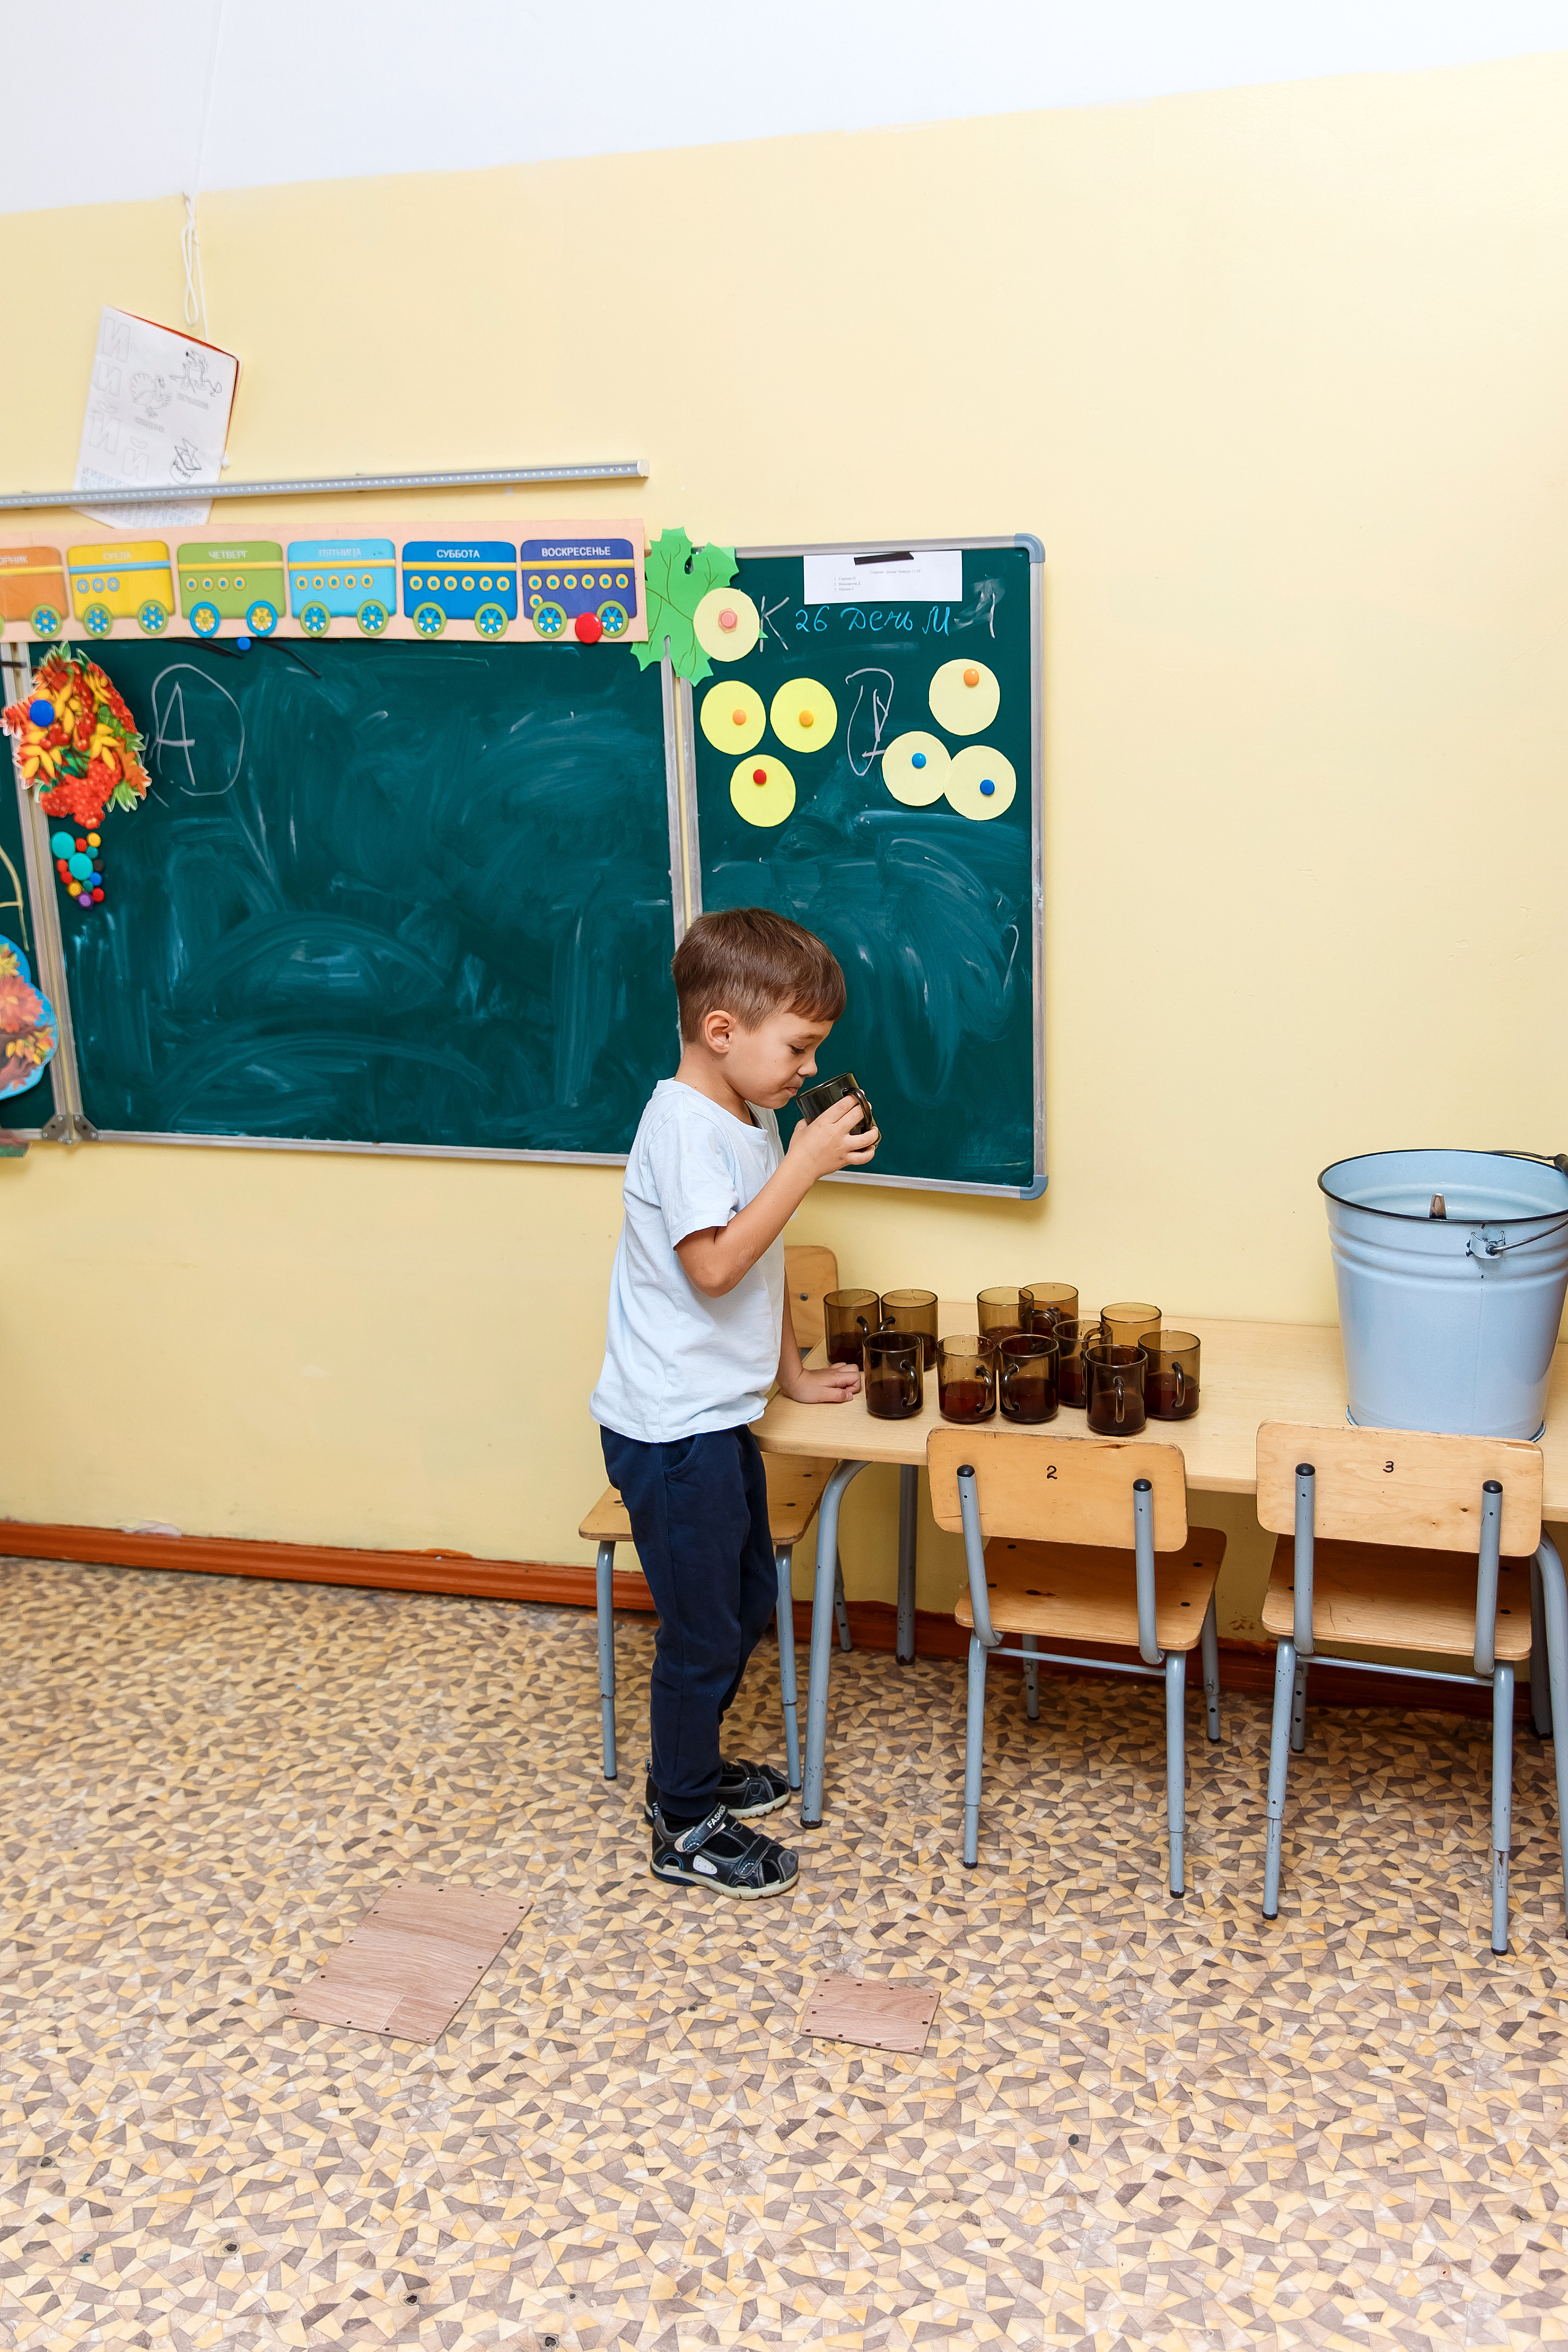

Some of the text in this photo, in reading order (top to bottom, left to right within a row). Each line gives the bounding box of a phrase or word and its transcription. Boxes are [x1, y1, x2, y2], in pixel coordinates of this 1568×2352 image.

[208, 550, 248, 559] ЧЕТВЕРГ
[318, 548, 361, 557] ПЯТНИЦА
[436, 549, 480, 559] СУББОТА
[541, 546, 611, 557] ВОСКРЕСЕНЬЕ
[796, 605, 830, 633] 26
[840, 607, 913, 632] День
[1382, 1460, 1394, 1473] 3
[1046, 1465, 1058, 1480] 2
